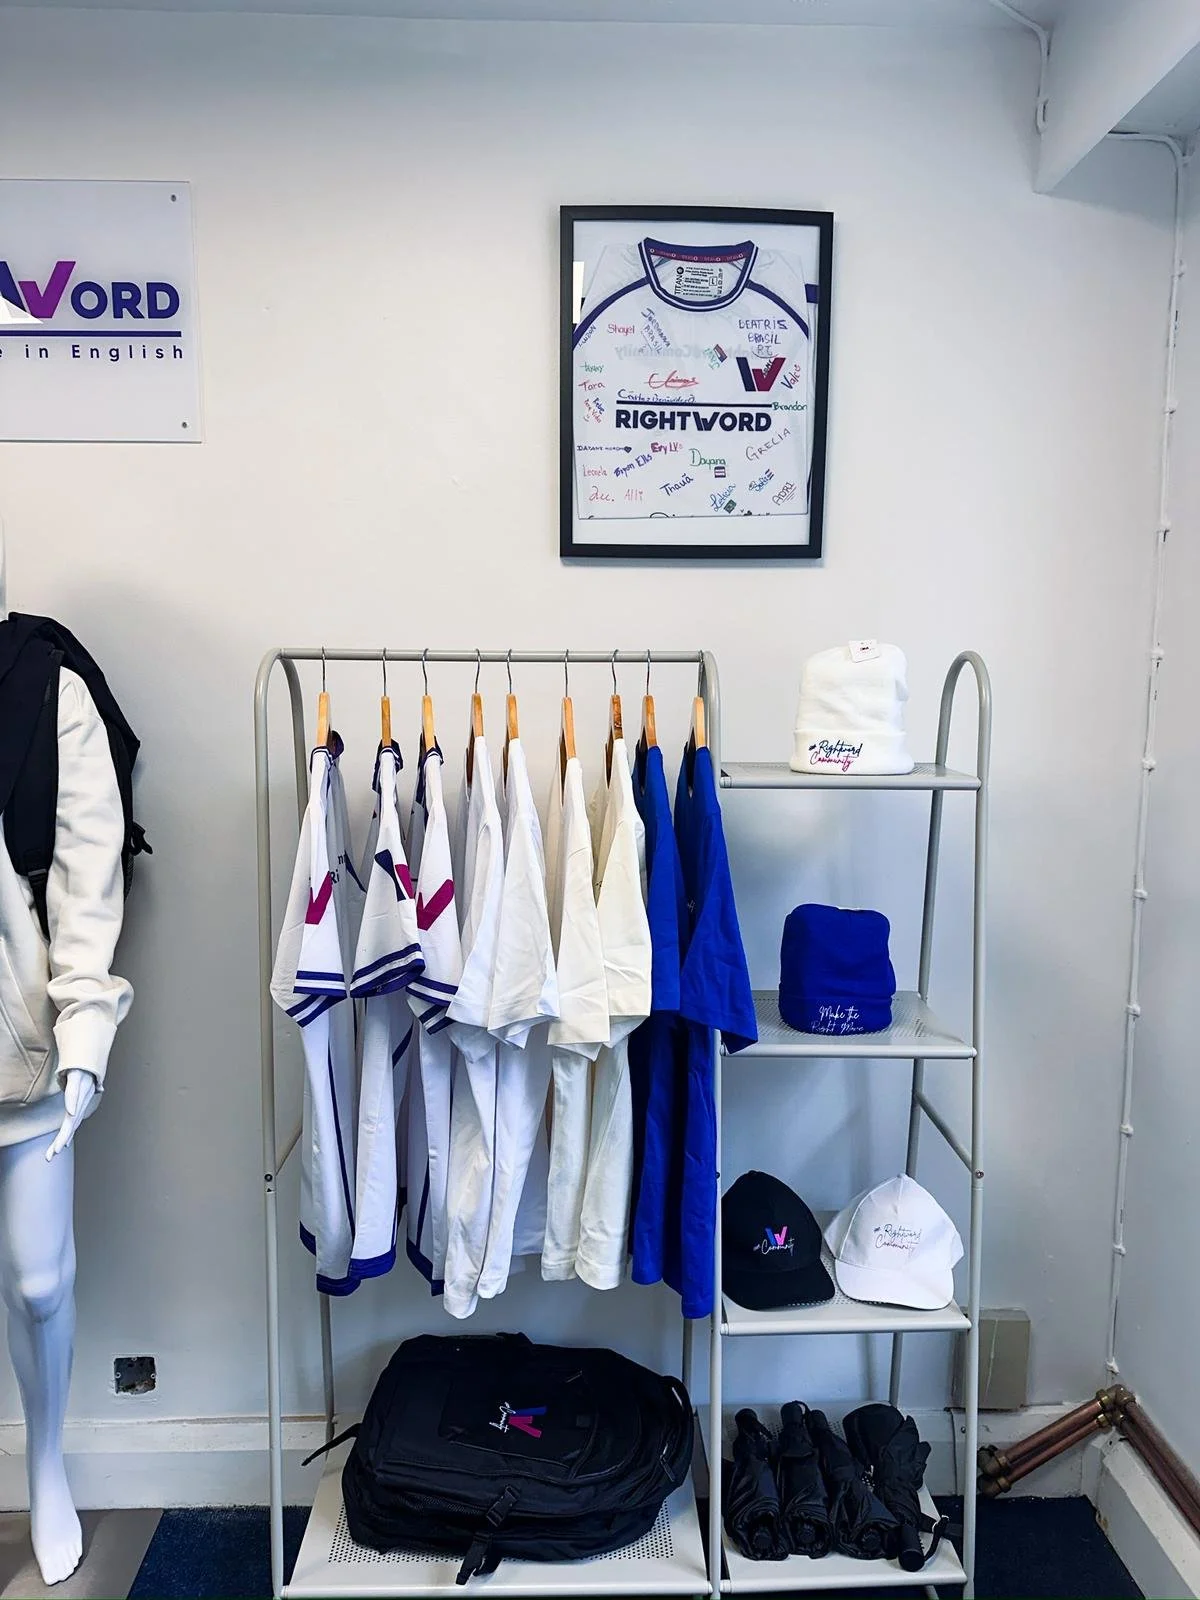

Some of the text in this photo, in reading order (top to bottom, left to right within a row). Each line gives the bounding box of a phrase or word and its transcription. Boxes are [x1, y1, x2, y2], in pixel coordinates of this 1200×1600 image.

[25, 345, 183, 362] in English
[578, 380, 605, 391] Tara
[773, 401, 808, 412] Brandon
[616, 410, 772, 432] RIGHTWORD
